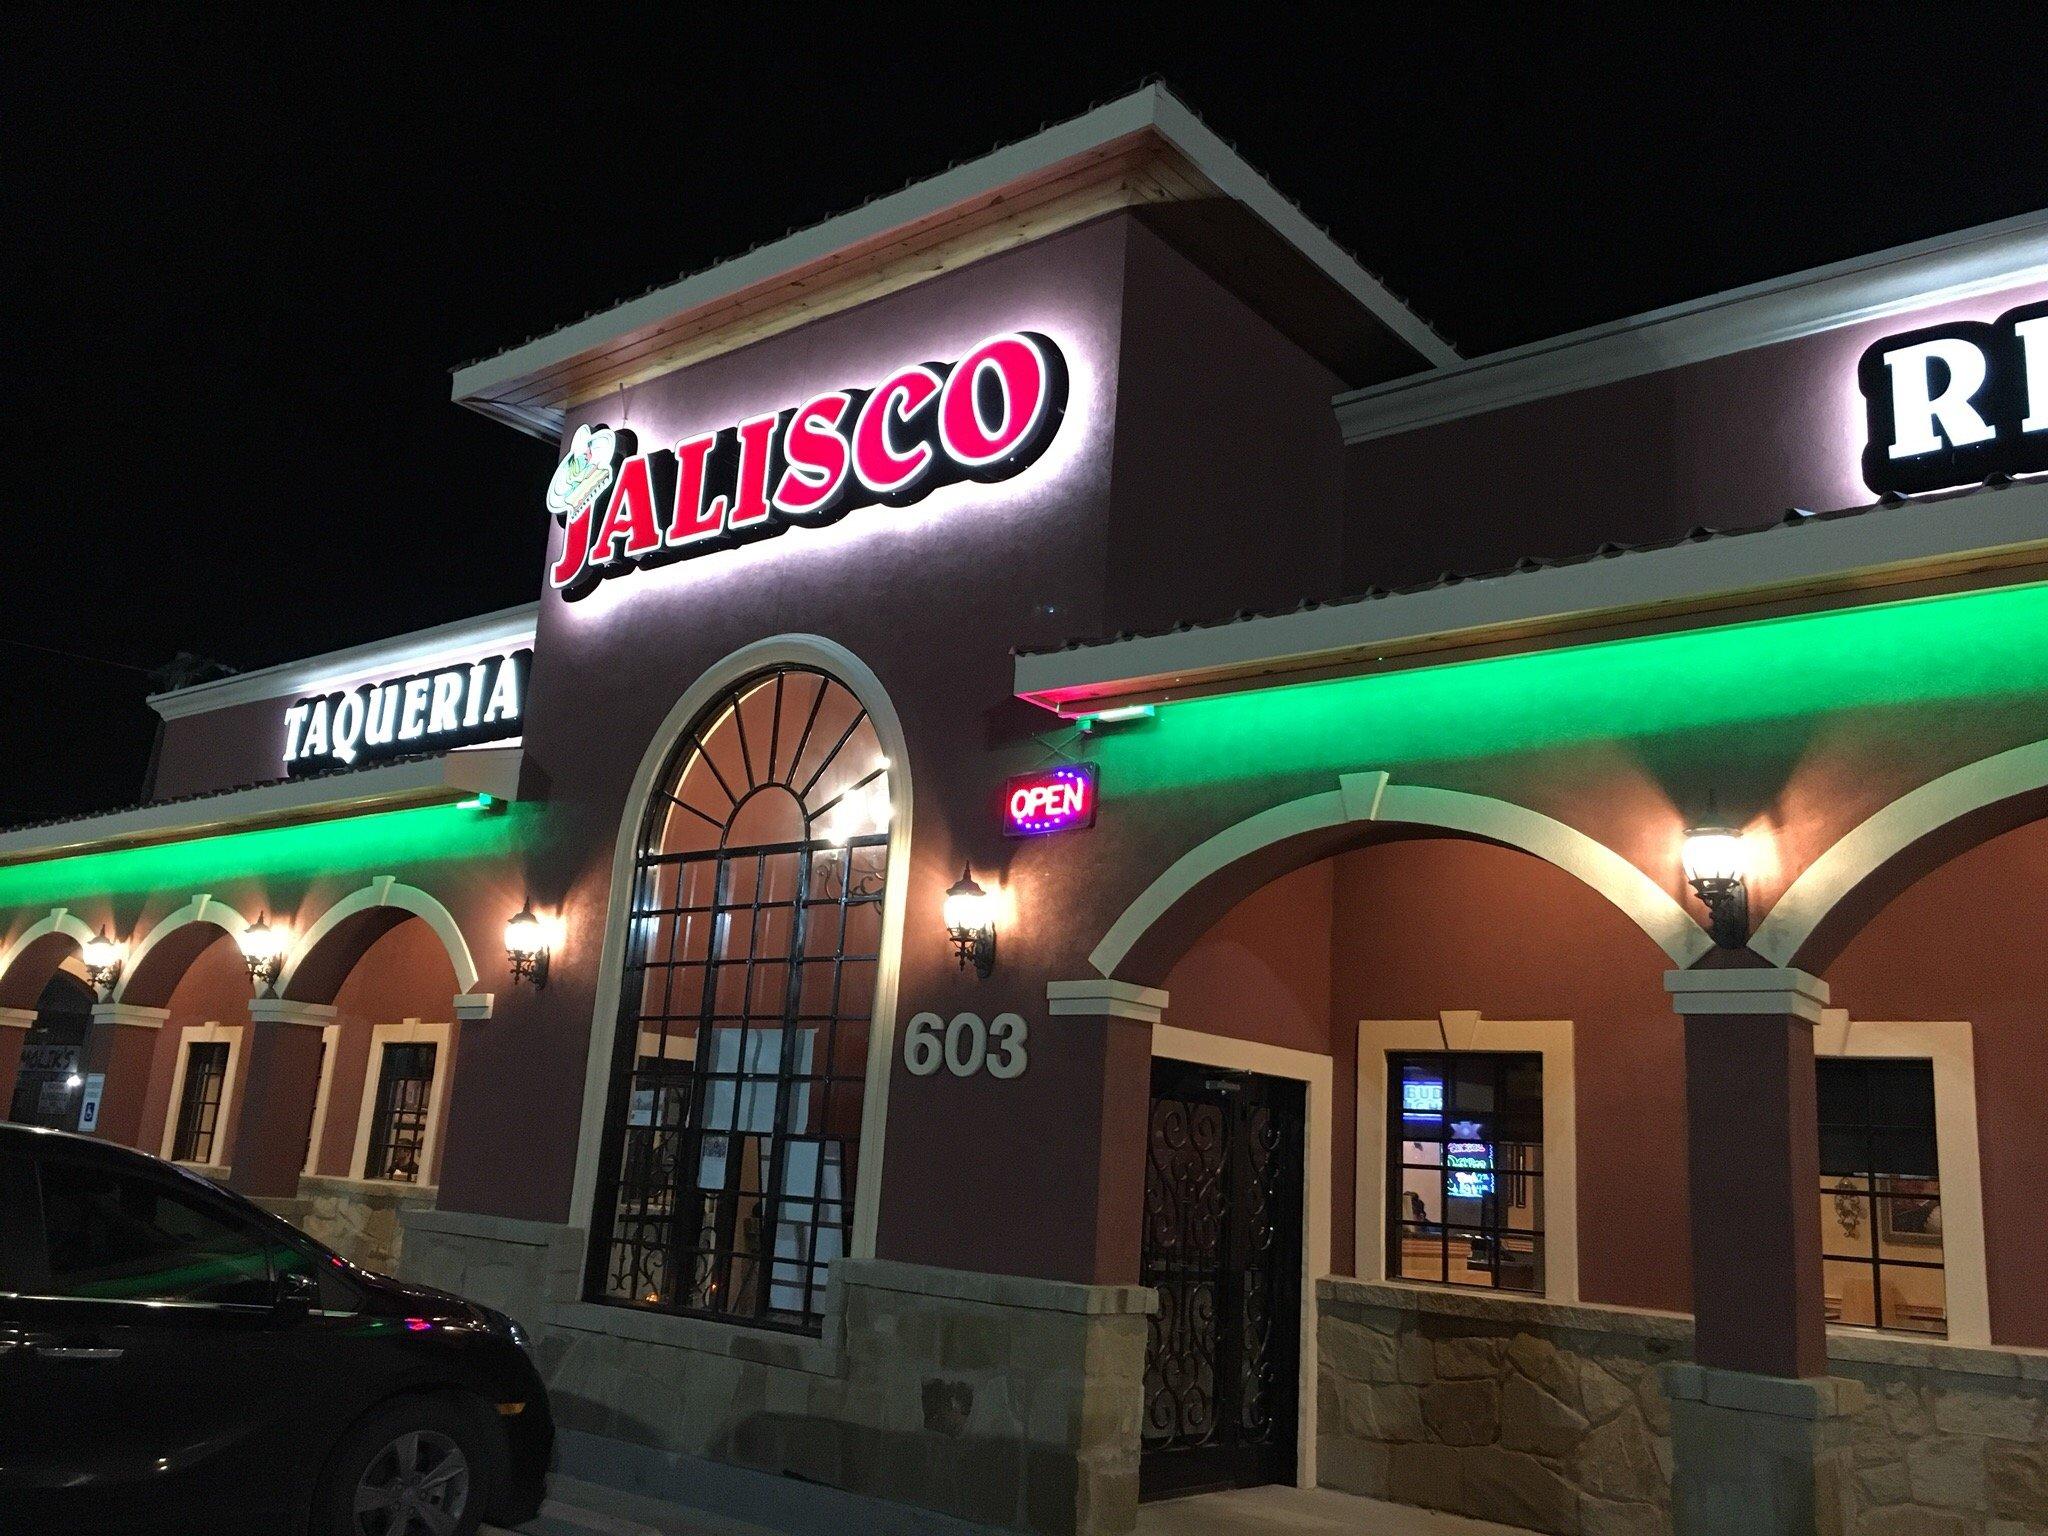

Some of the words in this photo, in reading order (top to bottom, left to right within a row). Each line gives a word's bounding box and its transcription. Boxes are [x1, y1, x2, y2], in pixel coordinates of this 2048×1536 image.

[549, 332, 1046, 588] JALISCO
[282, 658, 519, 764] TAQUERIA
[1009, 777, 1084, 819] OPEN
[904, 1011, 1028, 1079] 603
